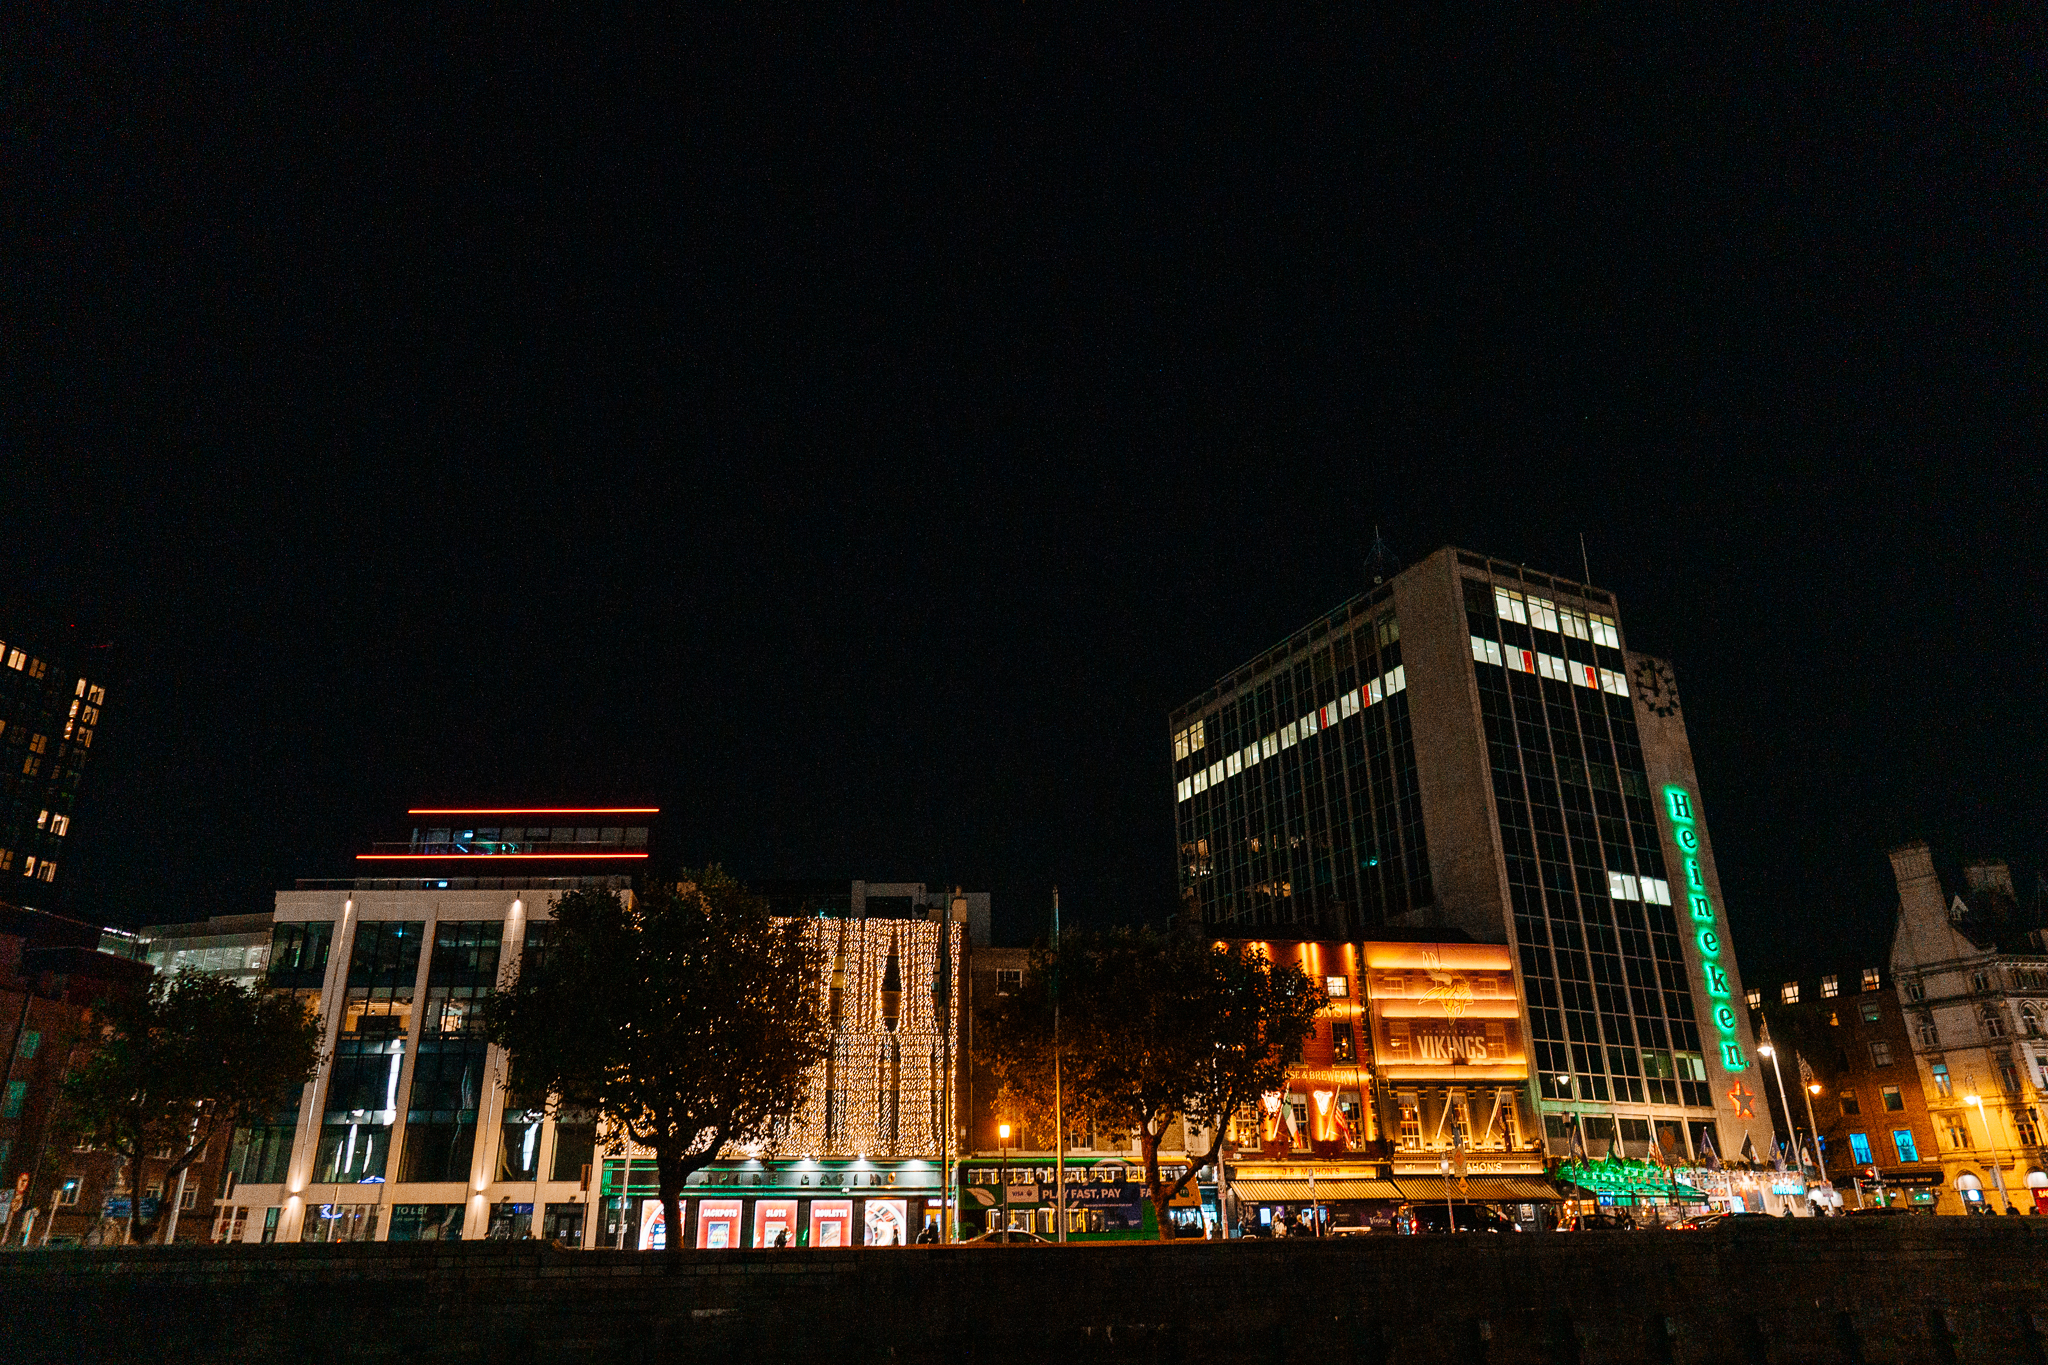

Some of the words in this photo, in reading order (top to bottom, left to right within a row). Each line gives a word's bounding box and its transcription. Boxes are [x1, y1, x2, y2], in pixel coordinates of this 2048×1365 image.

[1314, 1002, 1343, 1018] ON'S
[1416, 1035, 1488, 1059] VIKINGS
[1301, 1070, 1308, 1079] &
[1309, 1069, 1354, 1086] BREWERY
[1300, 1167, 1340, 1176] MHON'S
[1466, 1162, 1503, 1172] AHON'S
[800, 1171, 897, 1186] CASINO
[1071, 1188, 1100, 1199] FAST,
[1101, 1188, 1122, 1199] PAY
[1139, 1187, 1152, 1198] FA
[396, 1205, 409, 1216] TO
[410, 1205, 429, 1215] LET
[702, 1208, 738, 1218] JACKPOTS
[765, 1208, 787, 1218] SLOTS
[814, 1208, 848, 1219] ROULETTE
